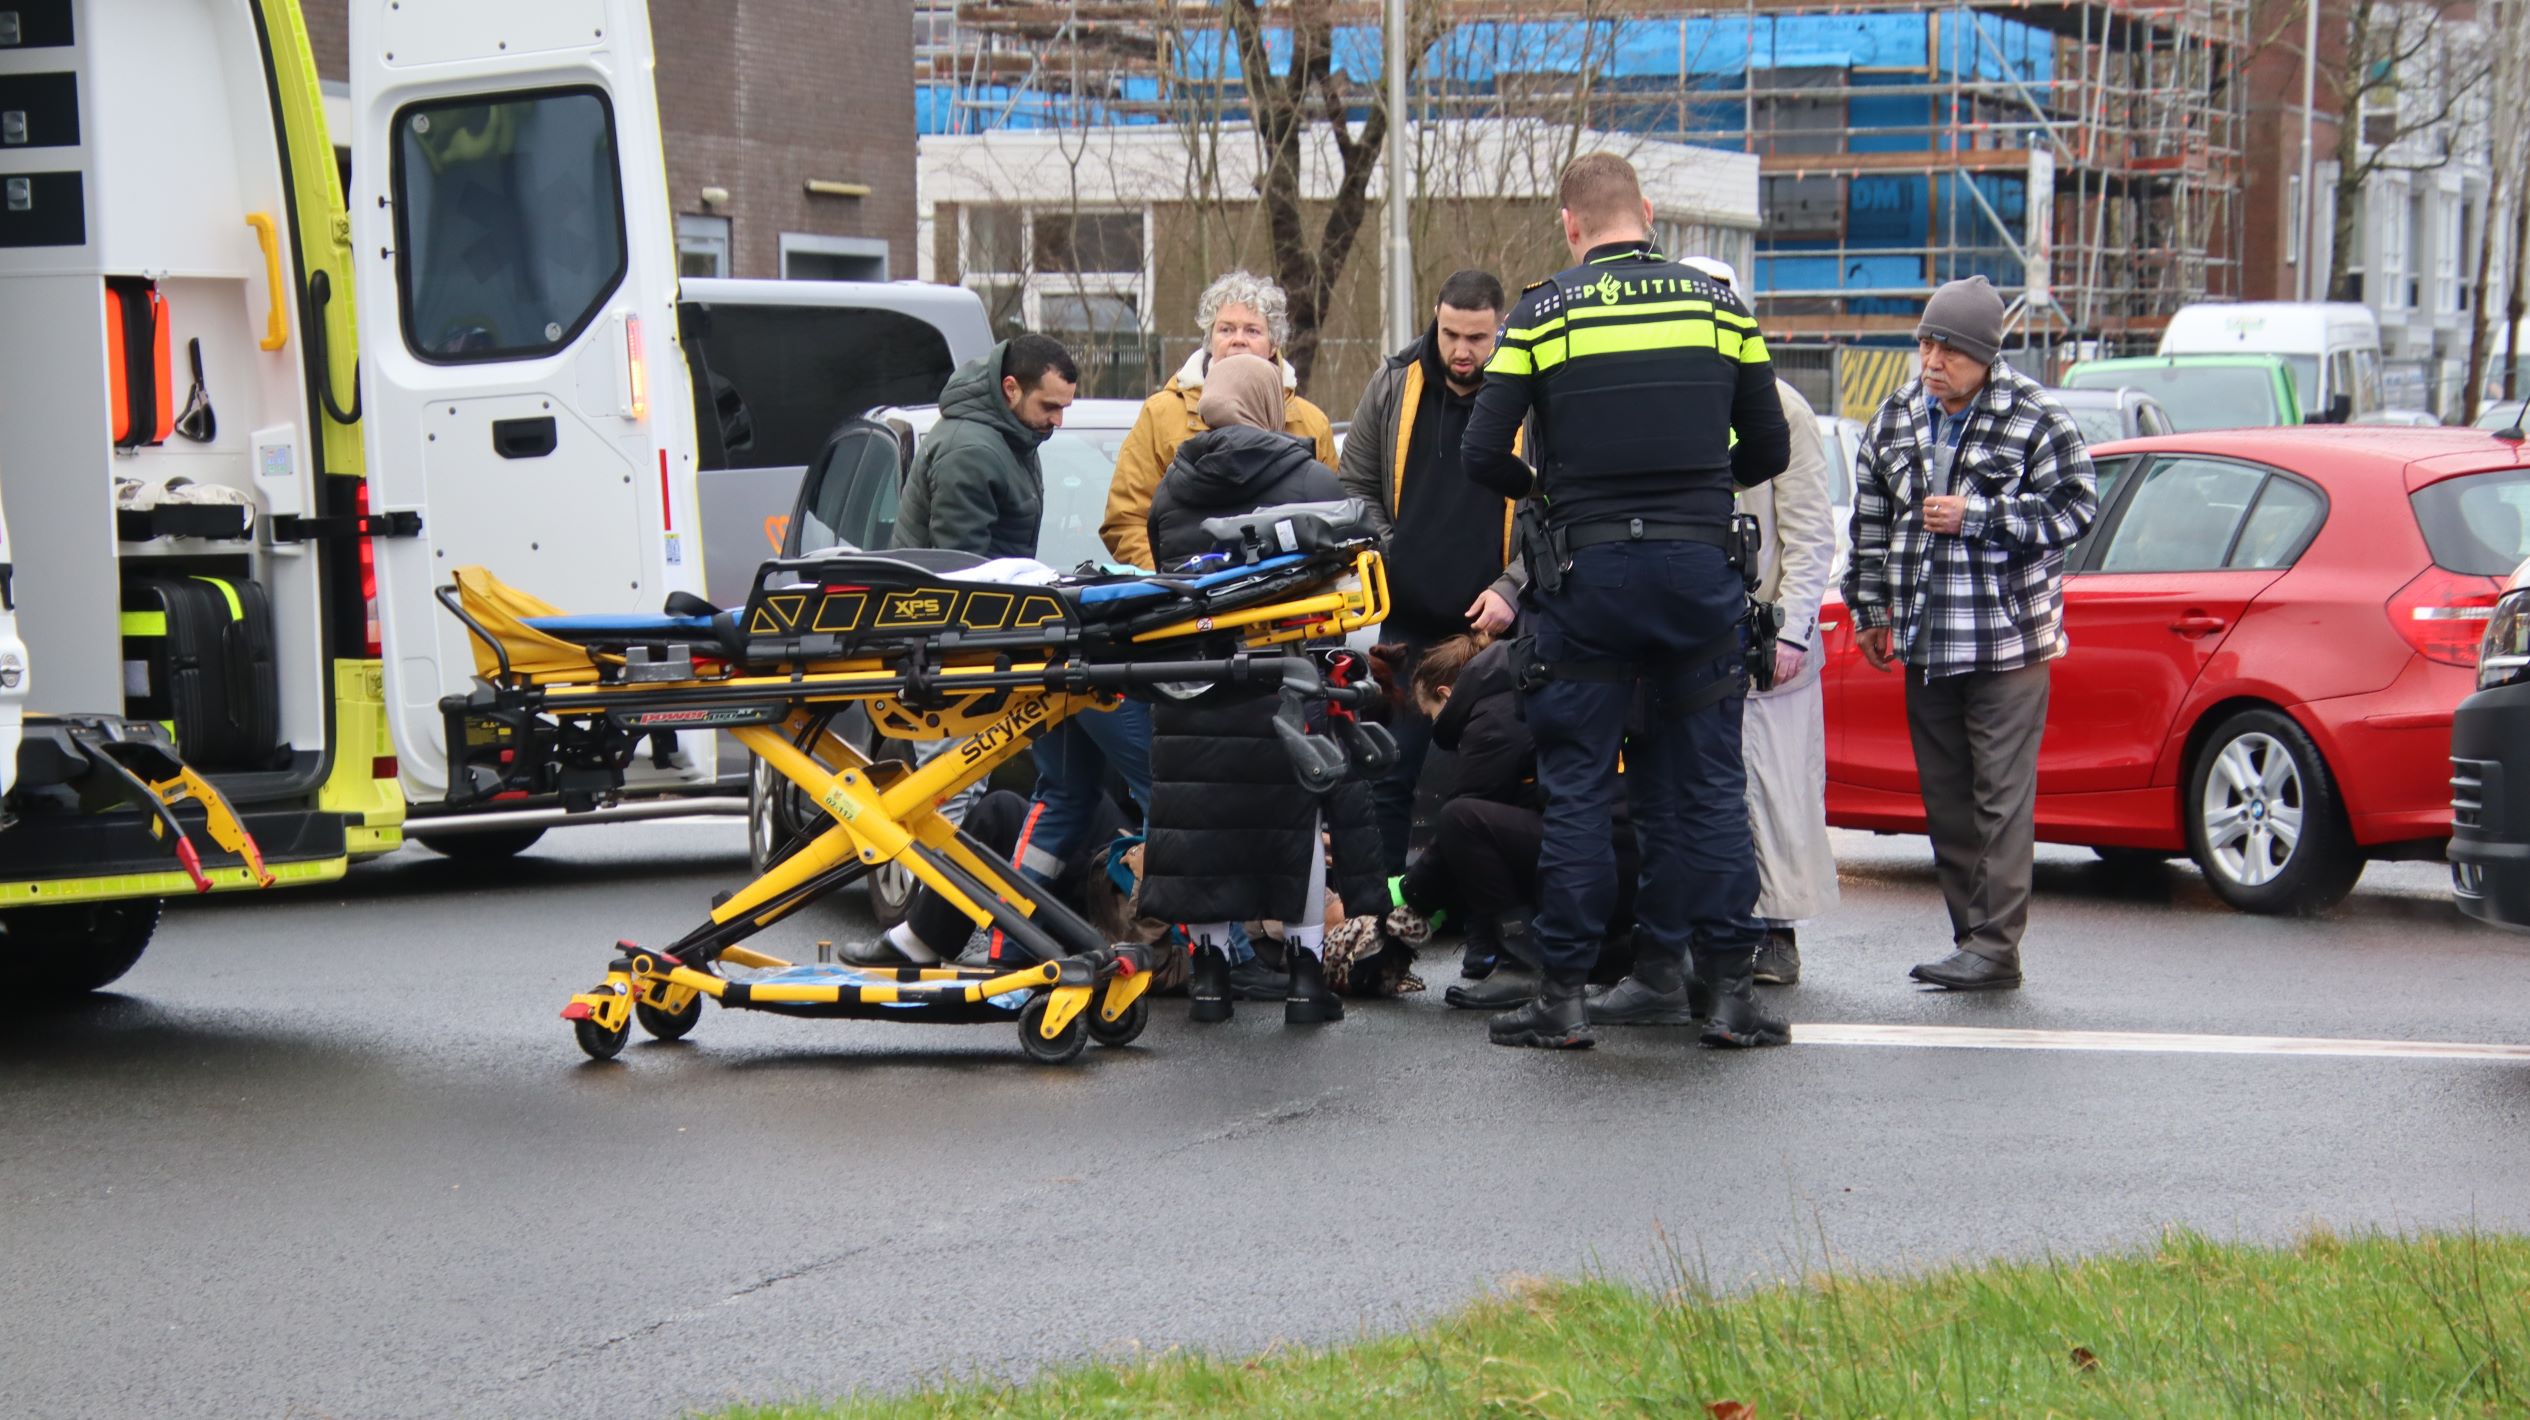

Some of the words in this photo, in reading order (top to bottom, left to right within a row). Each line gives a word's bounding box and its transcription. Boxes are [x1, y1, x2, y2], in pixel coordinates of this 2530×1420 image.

[1582, 272, 1693, 305] POLITIE
[894, 599, 940, 616] XPS
[641, 711, 708, 726] power
[961, 691, 1052, 765] stryker
